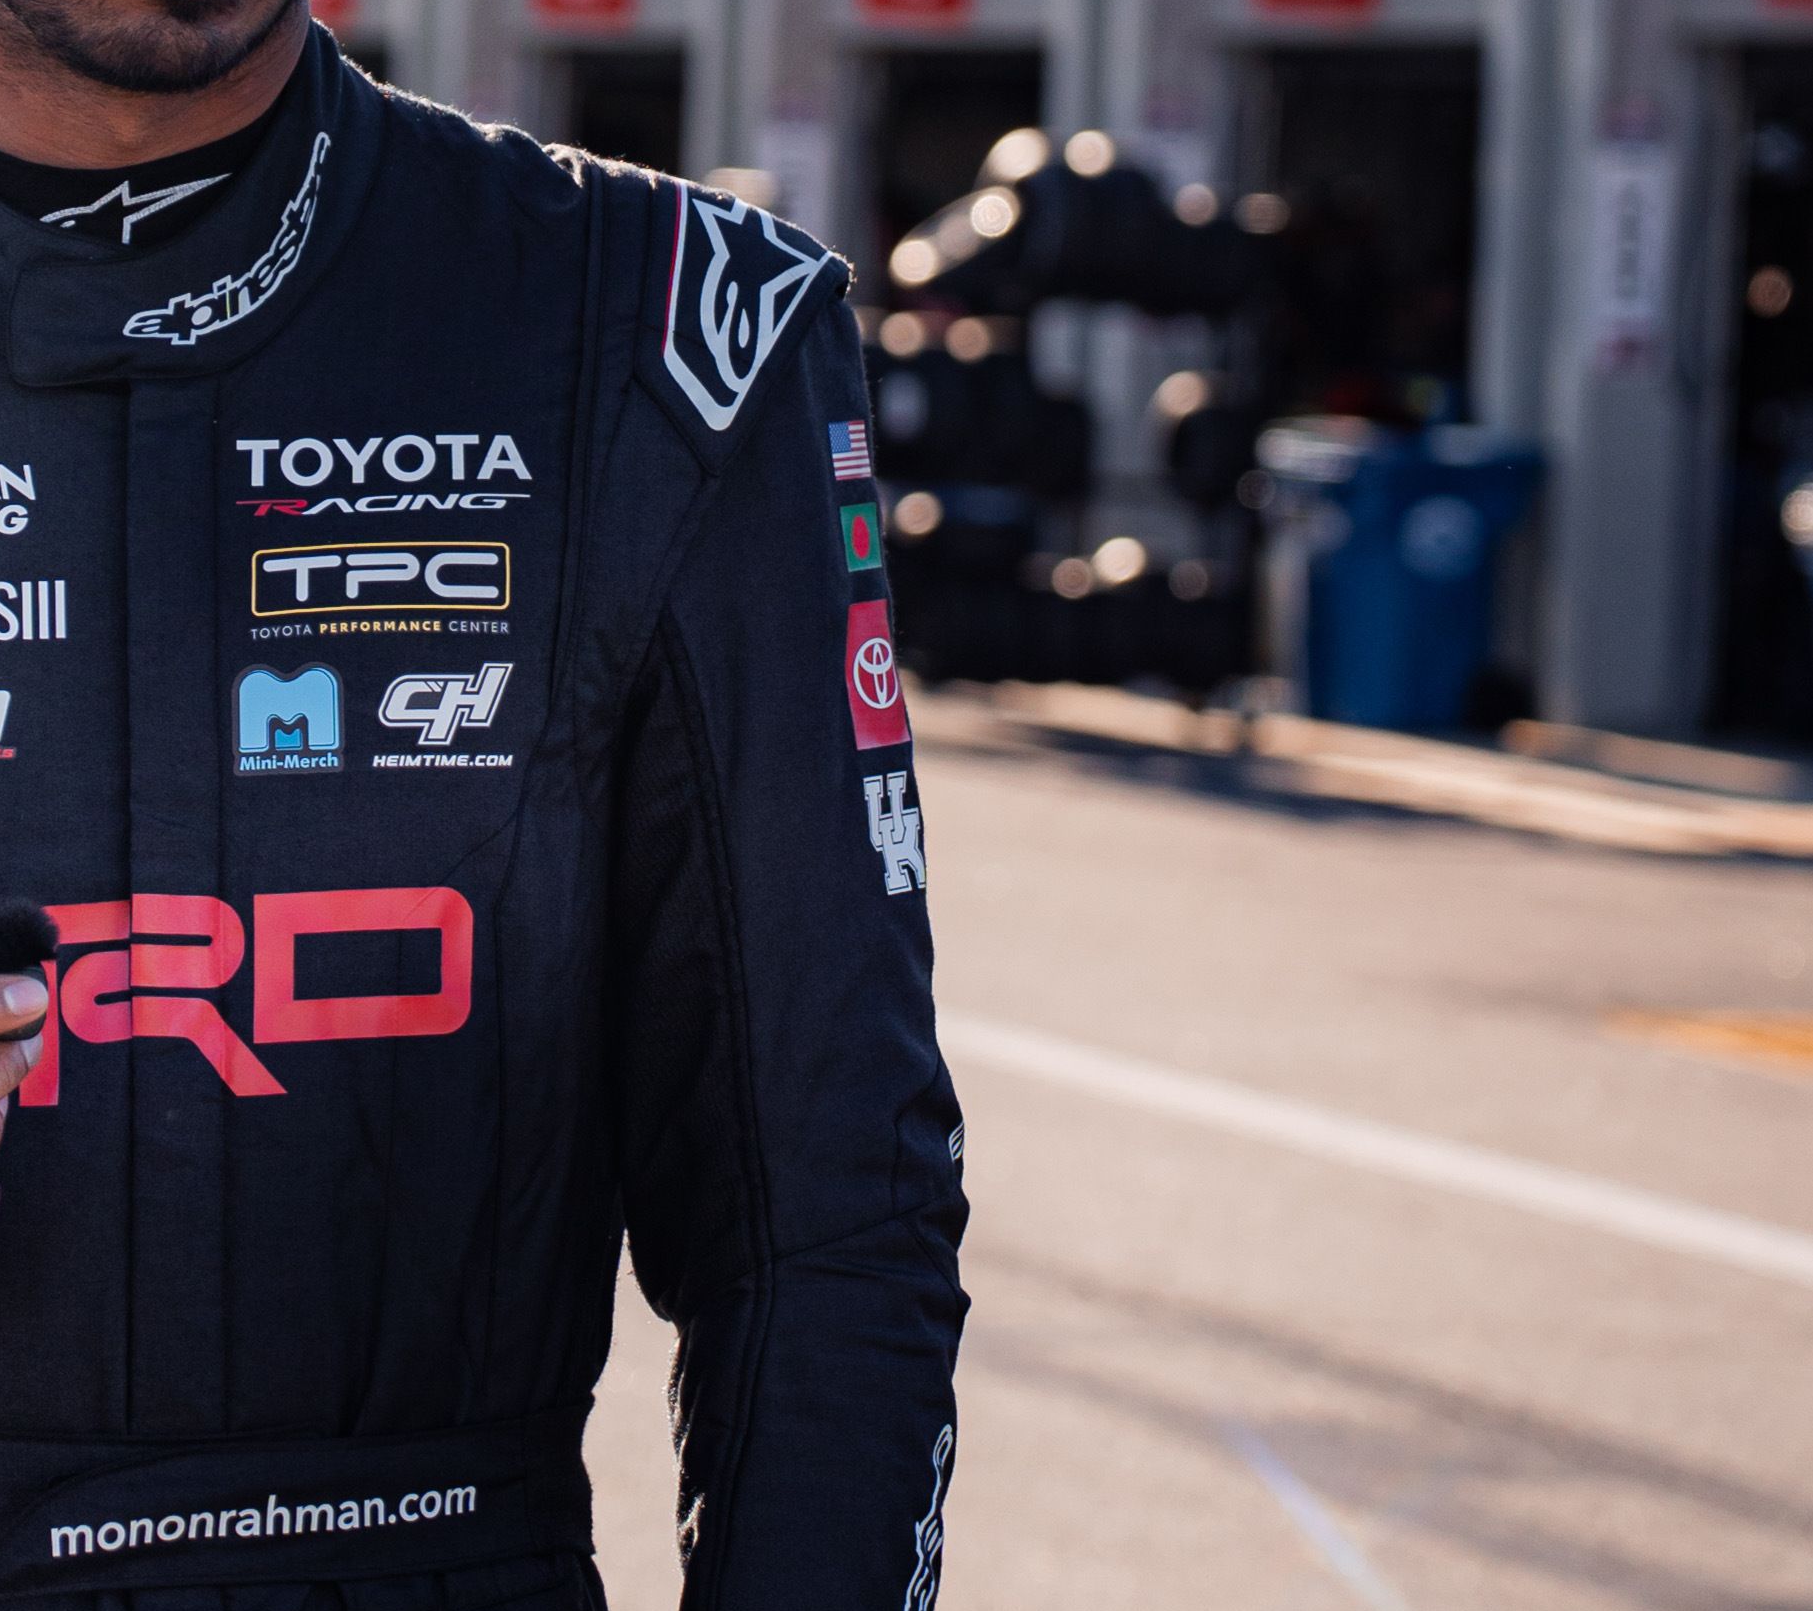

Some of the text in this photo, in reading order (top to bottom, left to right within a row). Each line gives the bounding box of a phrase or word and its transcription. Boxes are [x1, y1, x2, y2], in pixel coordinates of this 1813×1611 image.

[235, 433, 533, 487] TOYOTA
[235, 492, 532, 517] RACING
[262, 551, 500, 603] TPC
[251, 620, 510, 640] TOYOTA PERFORMANCE CENTER
[239, 752, 340, 773] Mini-Merch
[372, 754, 514, 769] HEIMTIME.COM
[49, 1484, 477, 1558] mononrahman.com
